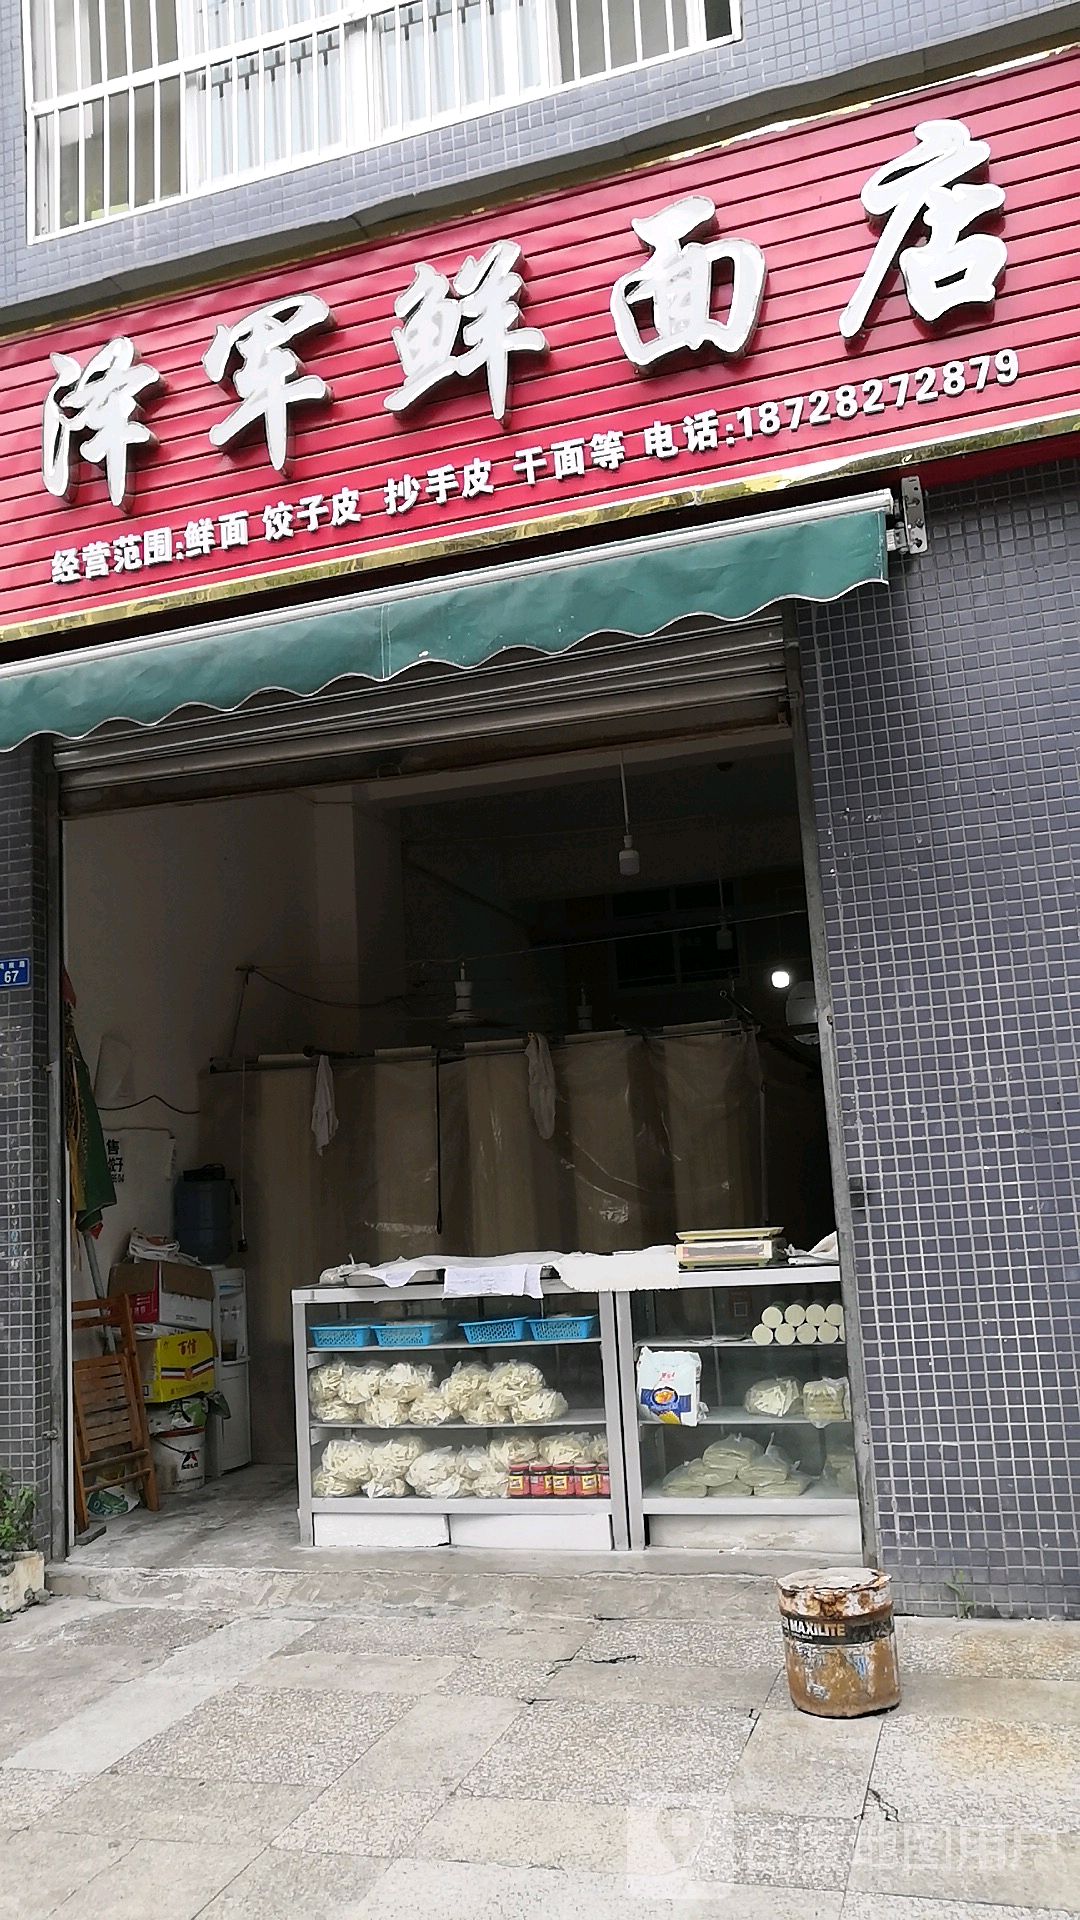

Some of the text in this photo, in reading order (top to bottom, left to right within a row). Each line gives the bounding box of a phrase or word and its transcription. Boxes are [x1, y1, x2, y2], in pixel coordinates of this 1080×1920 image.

[262, 486, 361, 541] 饺子皮
[383, 457, 494, 515] 抄手皮
[513, 430, 625, 484] 干面等
[4, 970, 19, 983] 67
[790, 1619, 846, 1637] MAXILITE
